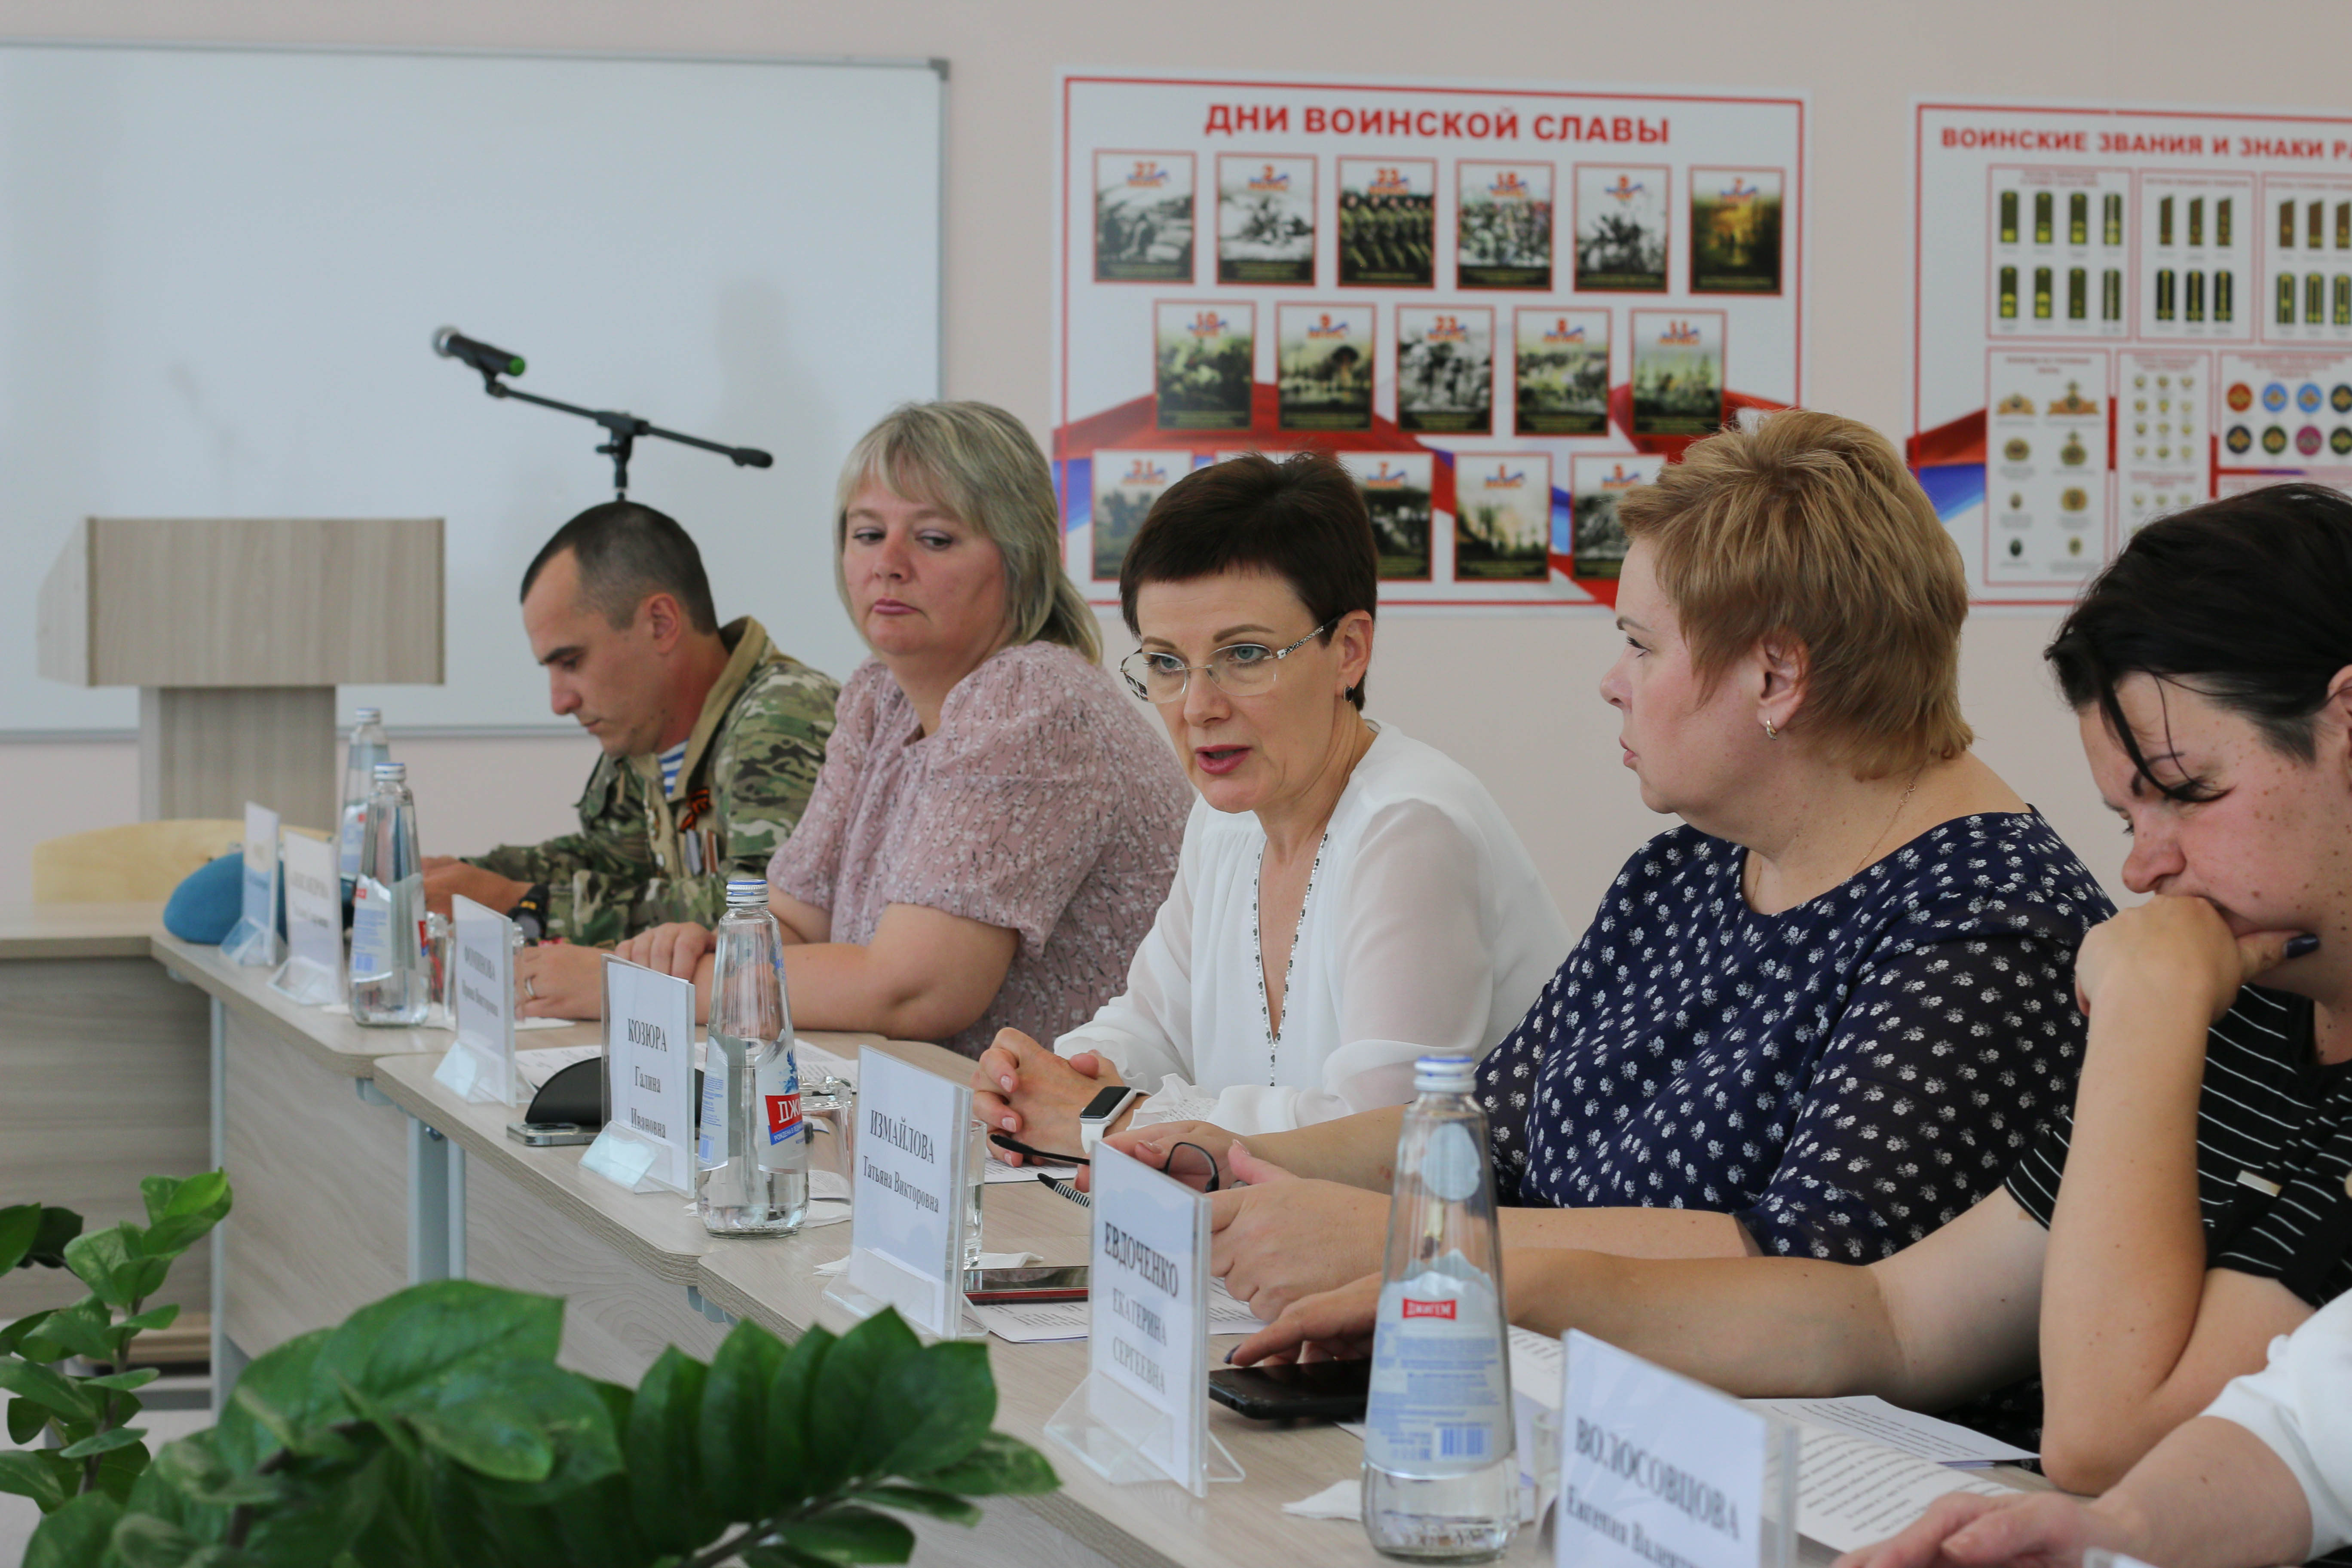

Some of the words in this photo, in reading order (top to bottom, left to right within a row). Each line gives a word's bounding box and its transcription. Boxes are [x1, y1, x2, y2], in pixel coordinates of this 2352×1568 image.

[1204, 104, 1288, 136] ДНИ
[1304, 106, 1519, 140] ВОИНСКОЙ
[1533, 114, 1669, 144] СЛАВЫ
[1941, 127, 2087, 152] ВОИНСКИЕ
[2098, 131, 2204, 156] ЗВАНИЯ
[2212, 135, 2230, 157] И
[2239, 136, 2324, 159] ЗНАКИ
[628, 1018, 667, 1052] КОЗЮРА
[635, 1066, 661, 1093] Галина
[631, 1107, 666, 1139] Ивановна
[870, 1109, 934, 1164] ИЗМАЙЛОВА
[864, 1155, 892, 1189] Татьяна
[894, 1171, 939, 1213] Викторовна
[1105, 1221, 1178, 1298] ЕВДОЧЕНКО
[1113, 1287, 1167, 1347] ЕКАТЕРИНА
[1113, 1336, 1166, 1395] СЕРГЕЕВНА
[1575, 1416, 1741, 1541] ВОЛОСОВЦОВА
